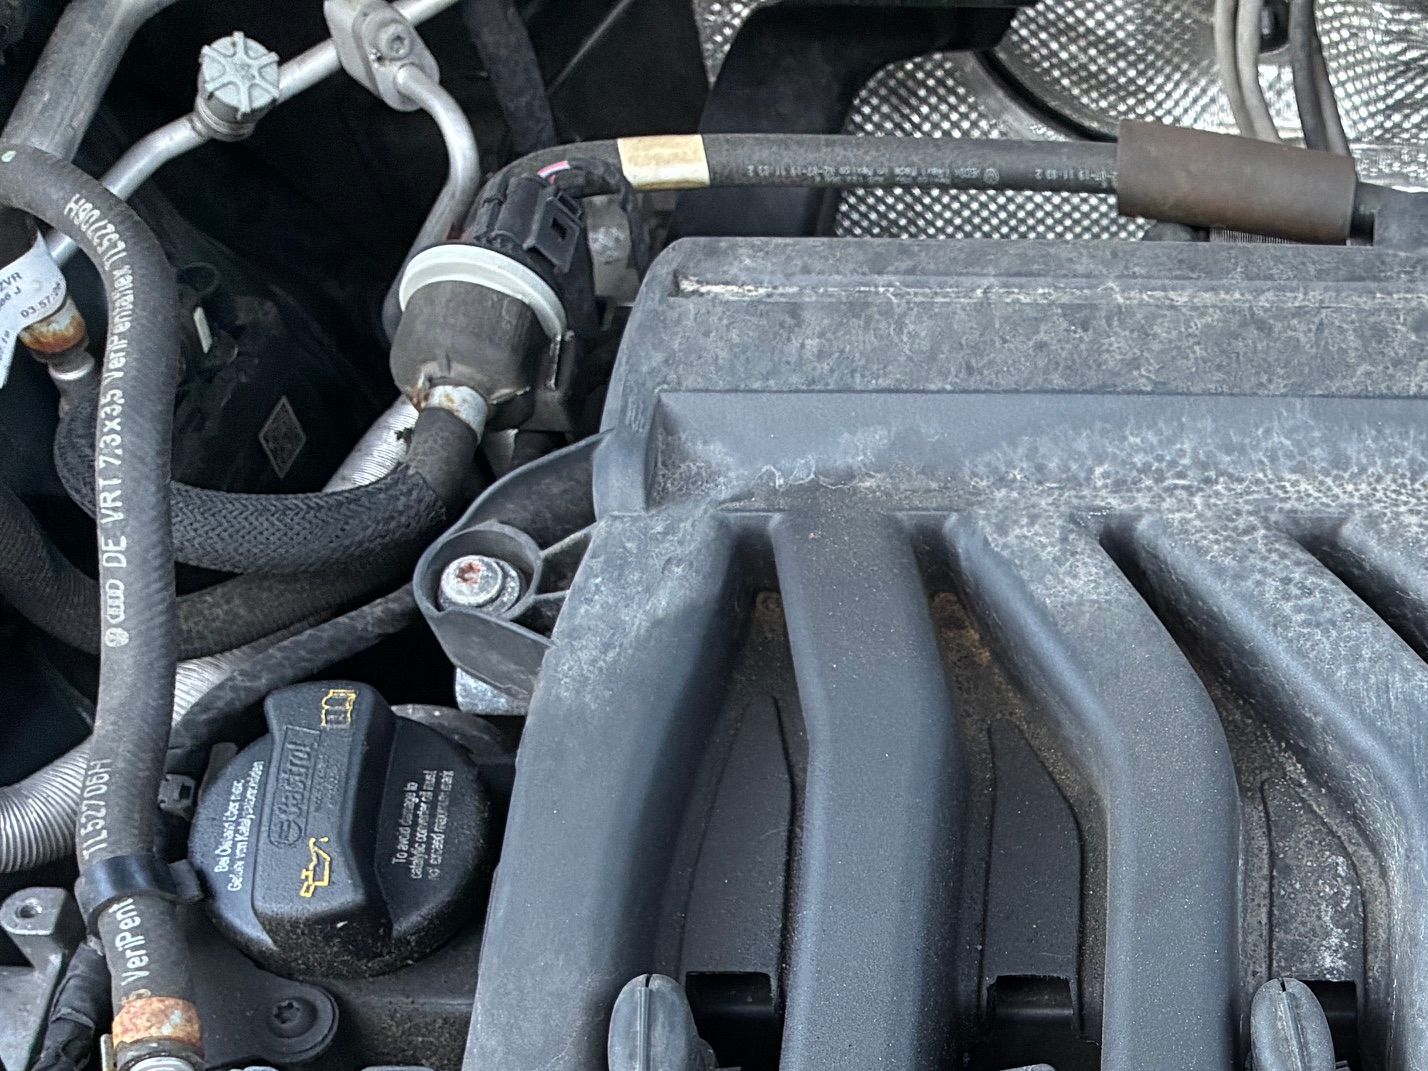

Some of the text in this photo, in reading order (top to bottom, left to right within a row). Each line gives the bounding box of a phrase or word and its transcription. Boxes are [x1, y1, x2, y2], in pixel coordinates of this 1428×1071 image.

[63, 193, 128, 271] TL52706H
[98, 477, 124, 525] VRT
[101, 535, 127, 568] DE
[80, 758, 112, 860] TL52706H
[391, 851, 409, 864] To
[396, 826, 412, 851] avoid
